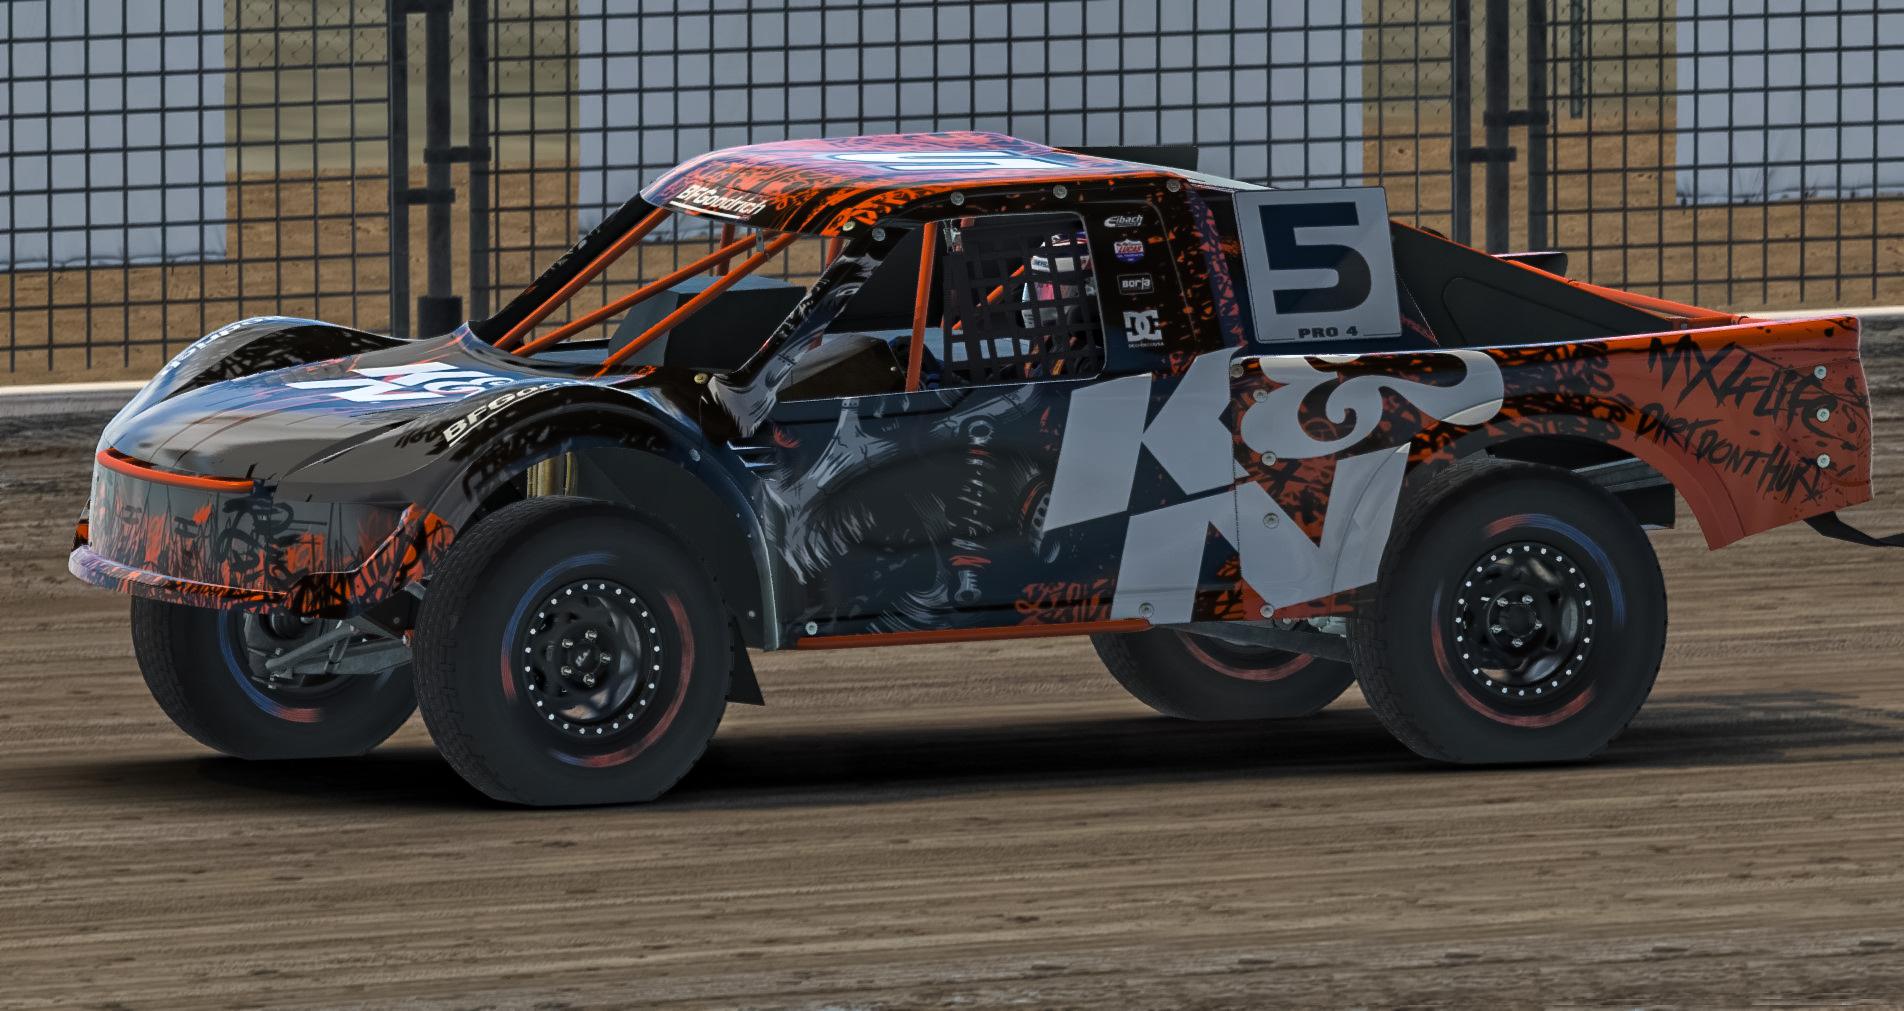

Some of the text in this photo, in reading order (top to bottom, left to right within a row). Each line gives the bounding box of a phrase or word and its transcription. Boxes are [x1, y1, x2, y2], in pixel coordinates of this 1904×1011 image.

[675, 184, 768, 215] BFGoodrich
[1258, 201, 1372, 315] 5
[1122, 309, 1163, 342] DC
[1298, 326, 1358, 339] PRO 4
[1042, 346, 1505, 625] K&N
